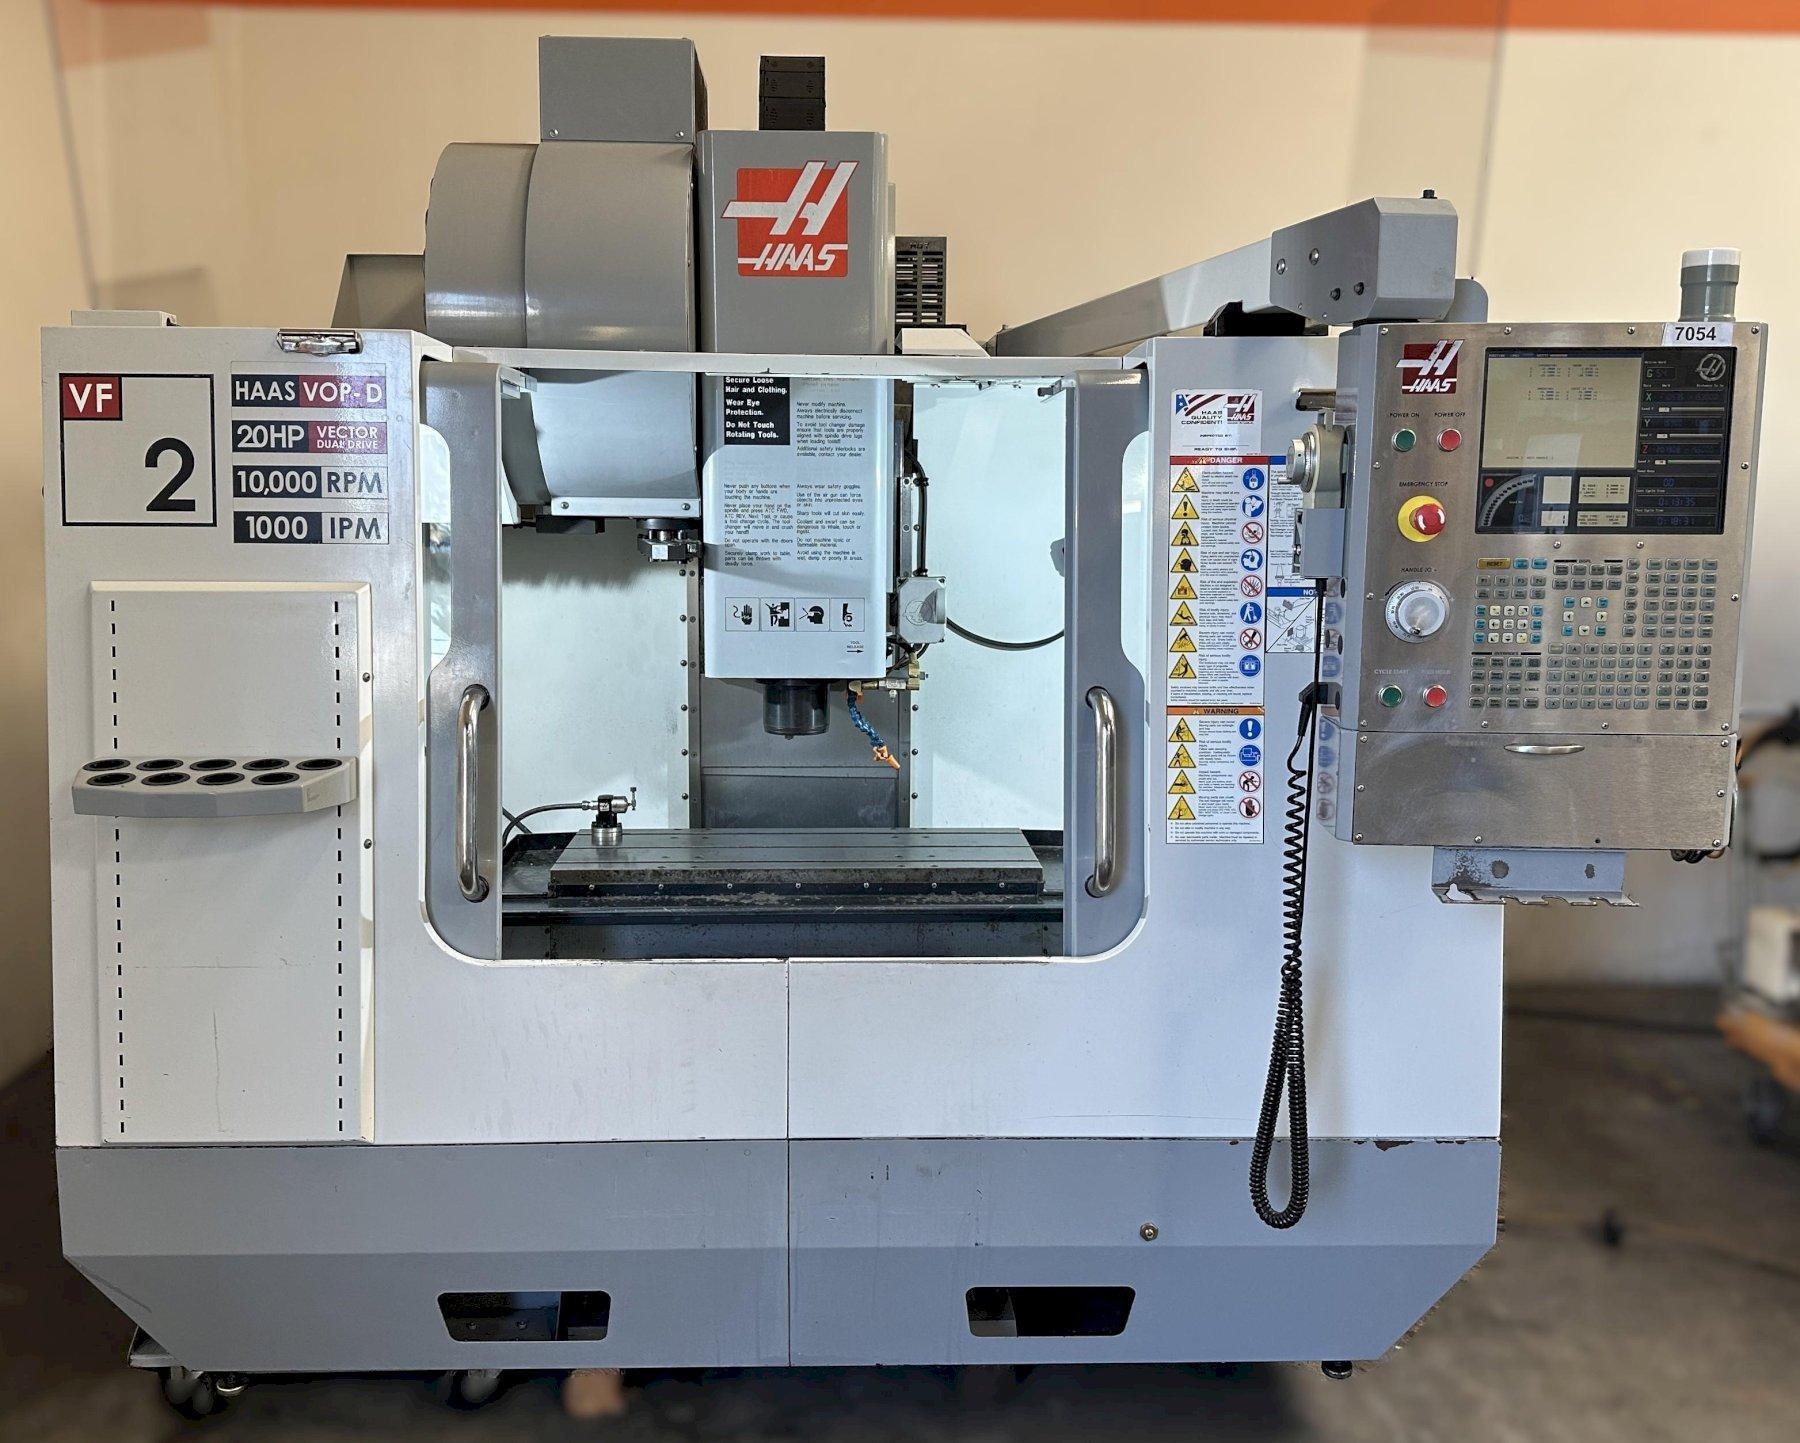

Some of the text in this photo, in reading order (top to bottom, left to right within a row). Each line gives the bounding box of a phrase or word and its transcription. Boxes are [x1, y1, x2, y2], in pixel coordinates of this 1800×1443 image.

[738, 243, 848, 271] HAAS
[1674, 326, 1717, 341] 7054
[235, 381, 296, 401] HAAS
[758, 386, 787, 394] Clothing.
[1402, 378, 1458, 392] HAAS
[68, 383, 113, 413] VF
[747, 399, 760, 407] Eye
[237, 425, 378, 448] 20HP VECTOR
[316, 440, 378, 449] DUAL DRIVE
[725, 431, 755, 439] Rotating
[145, 437, 196, 512] 2
[237, 470, 382, 496] 10,000 RPM
[246, 516, 381, 539] 1000 IPM
